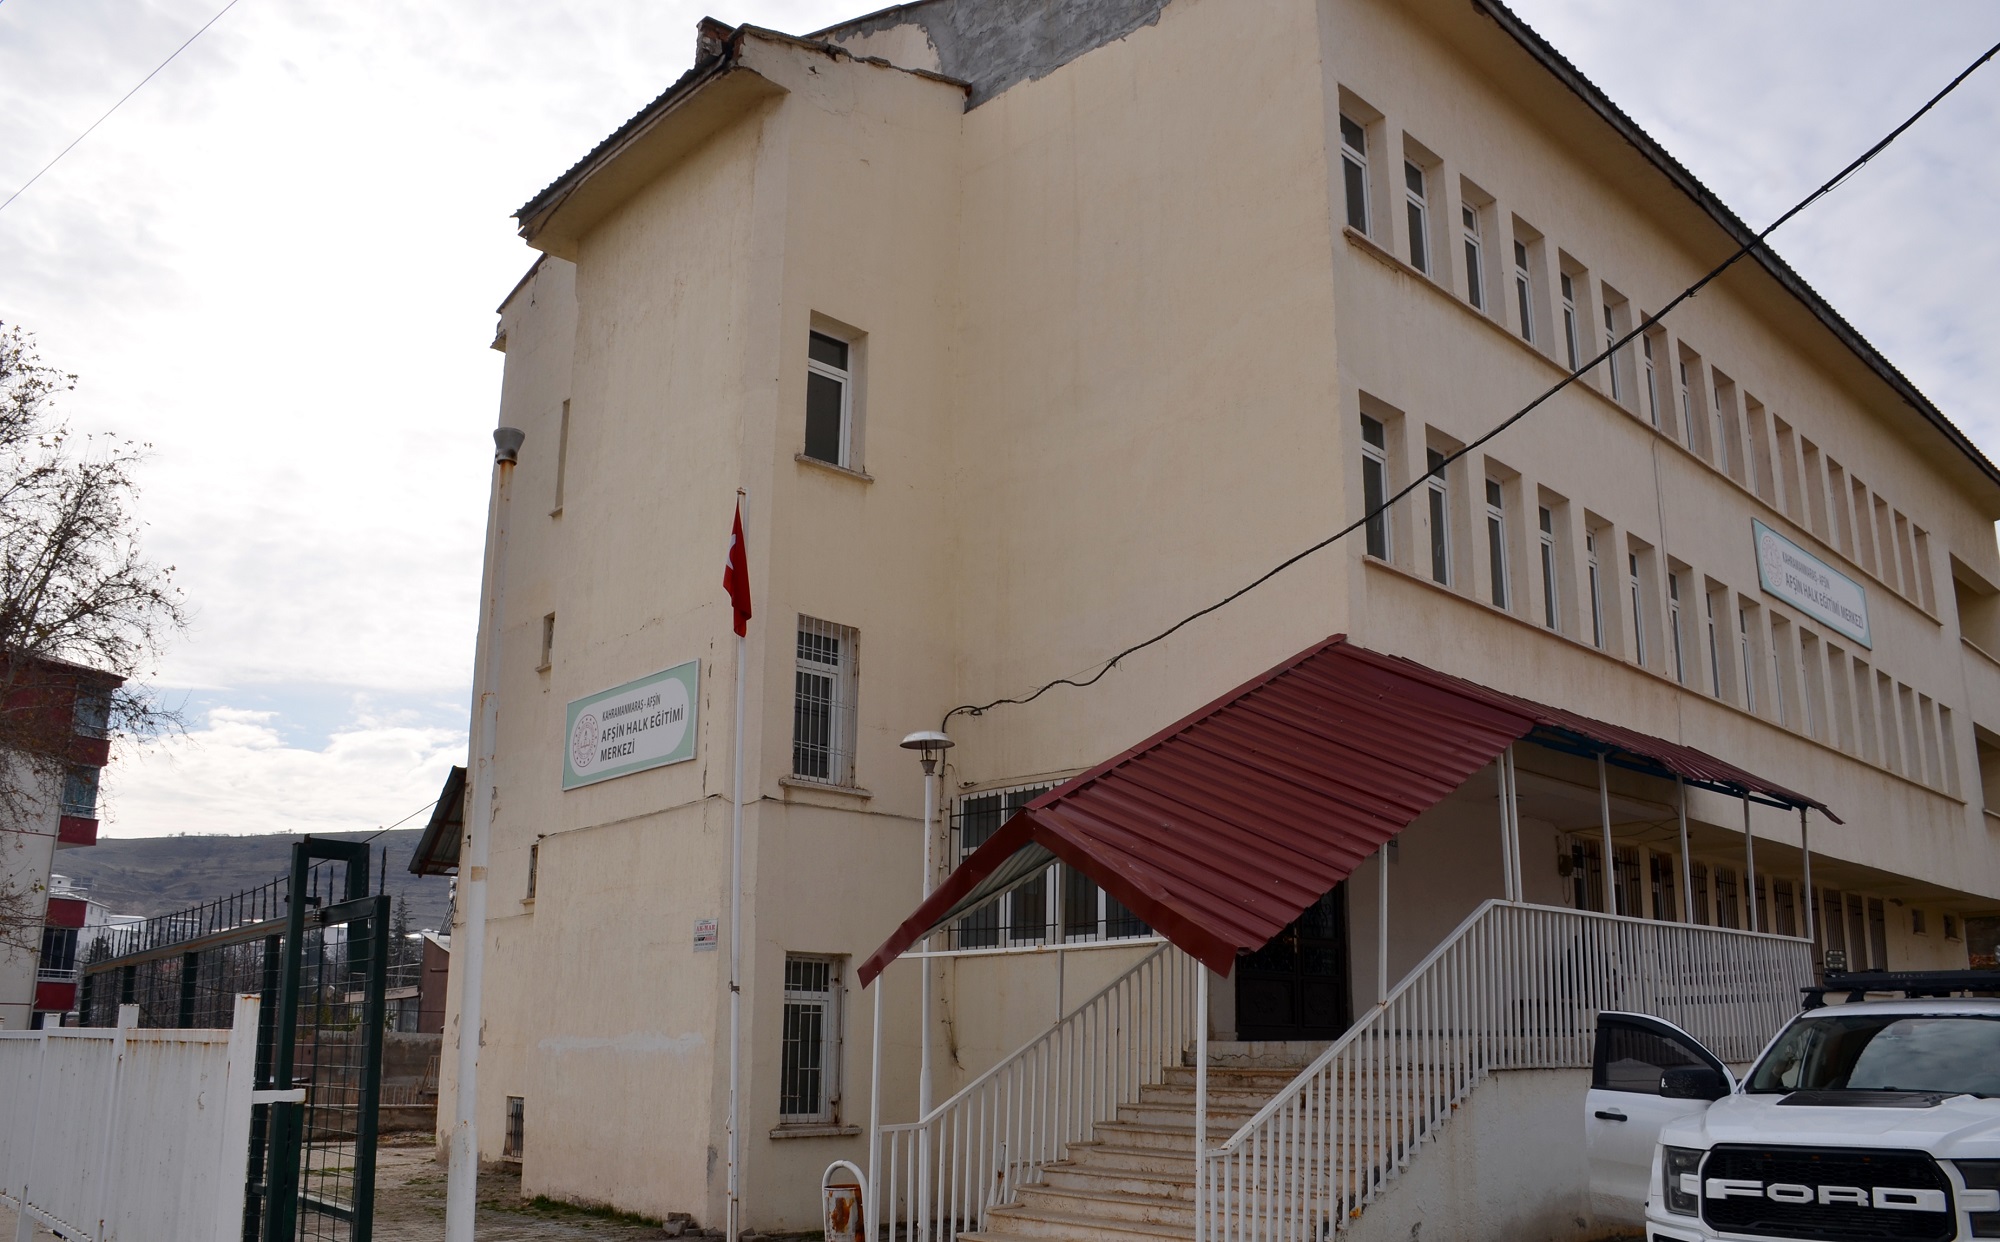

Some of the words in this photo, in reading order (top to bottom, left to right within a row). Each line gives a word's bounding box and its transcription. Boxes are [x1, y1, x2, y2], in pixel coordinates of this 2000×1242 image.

[1782, 552, 1817, 583] KAHRAMANMARAŞ
[1819, 574, 1830, 591] AFŞİN
[1785, 572, 1803, 595] AFŞİN
[1803, 583, 1819, 605] HALK
[1819, 592, 1841, 617] EĞİTİMİ
[1840, 605, 1864, 630] MERKEZİ
[601, 722, 625, 742] AFŞİN
[626, 717, 648, 736] HALK
[650, 704, 684, 729] EĞİTİMİ
[602, 699, 644, 721] KAHRAMANMARAŞ
[647, 692, 661, 709] AFŞİN
[600, 738, 635, 762] MERKEZİ
[1706, 1177, 1947, 1212] FORD
